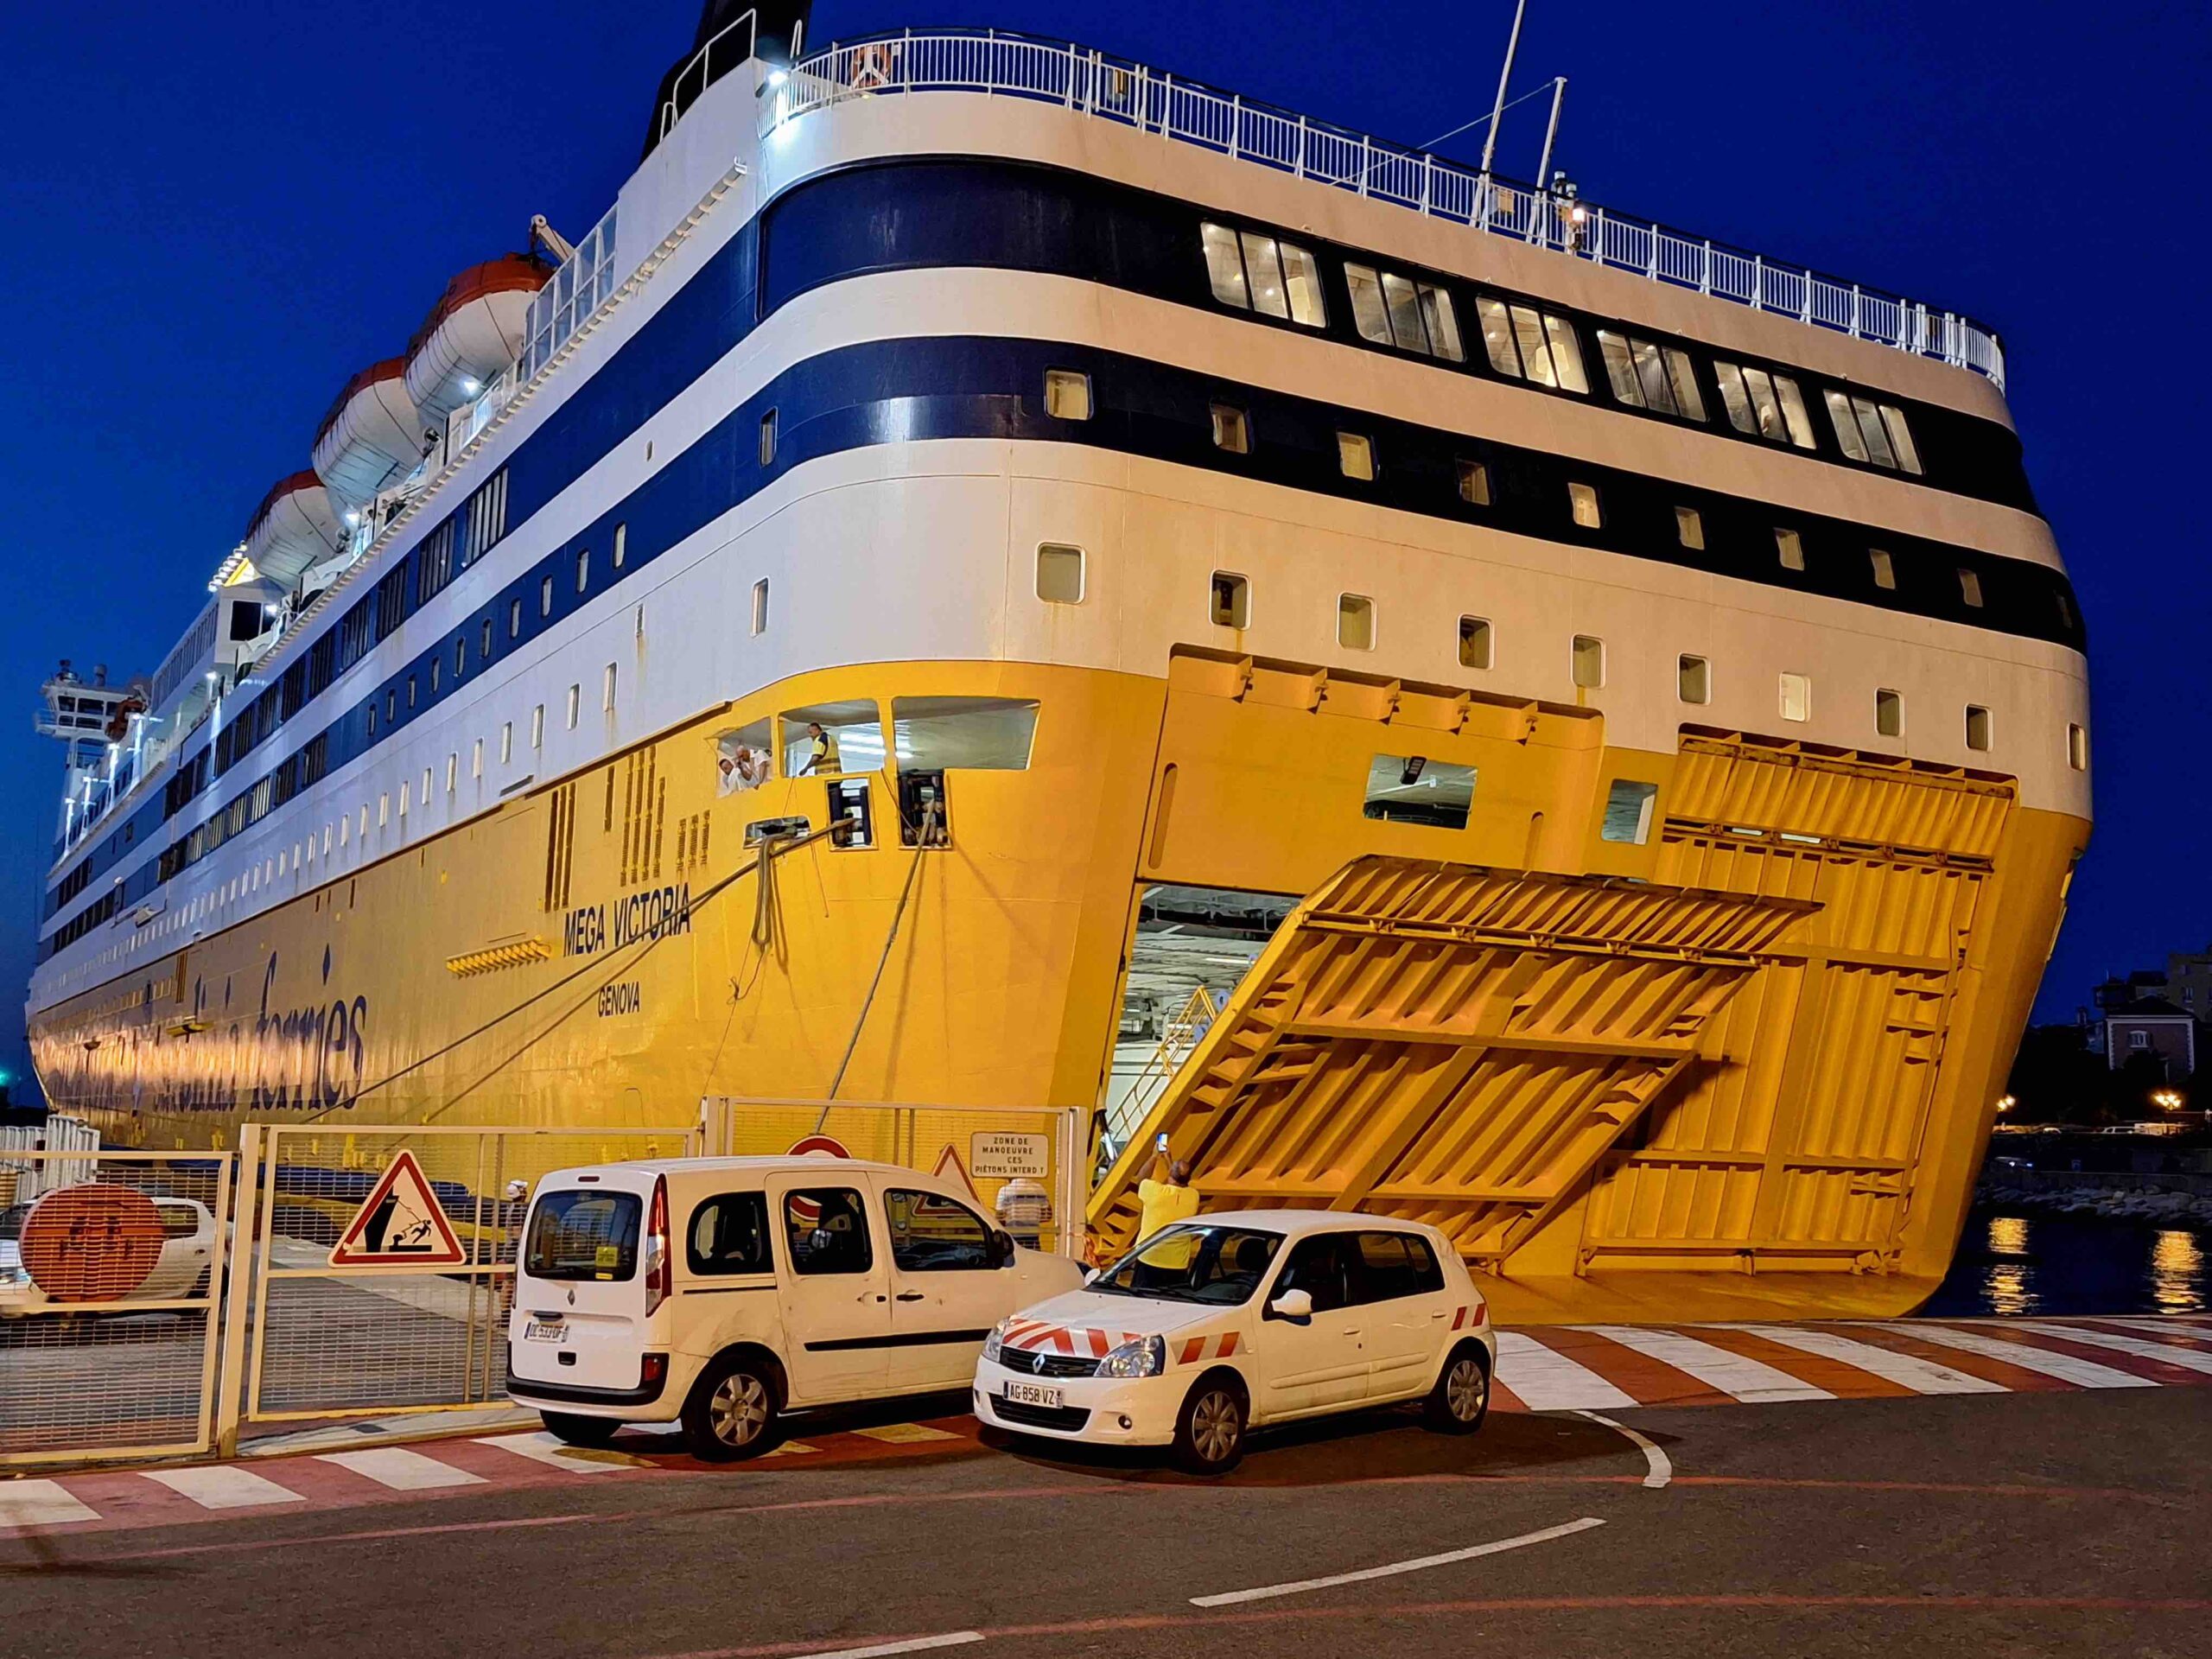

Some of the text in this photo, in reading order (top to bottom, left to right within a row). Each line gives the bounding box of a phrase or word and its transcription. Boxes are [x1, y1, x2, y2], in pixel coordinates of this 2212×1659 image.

[563, 881, 690, 957] MEGA VICTORIA
[598, 982, 640, 1018] GENOVA
[982, 1147, 1033, 1155] MANOEUVRE
[994, 1136, 1015, 1145] ZONE
